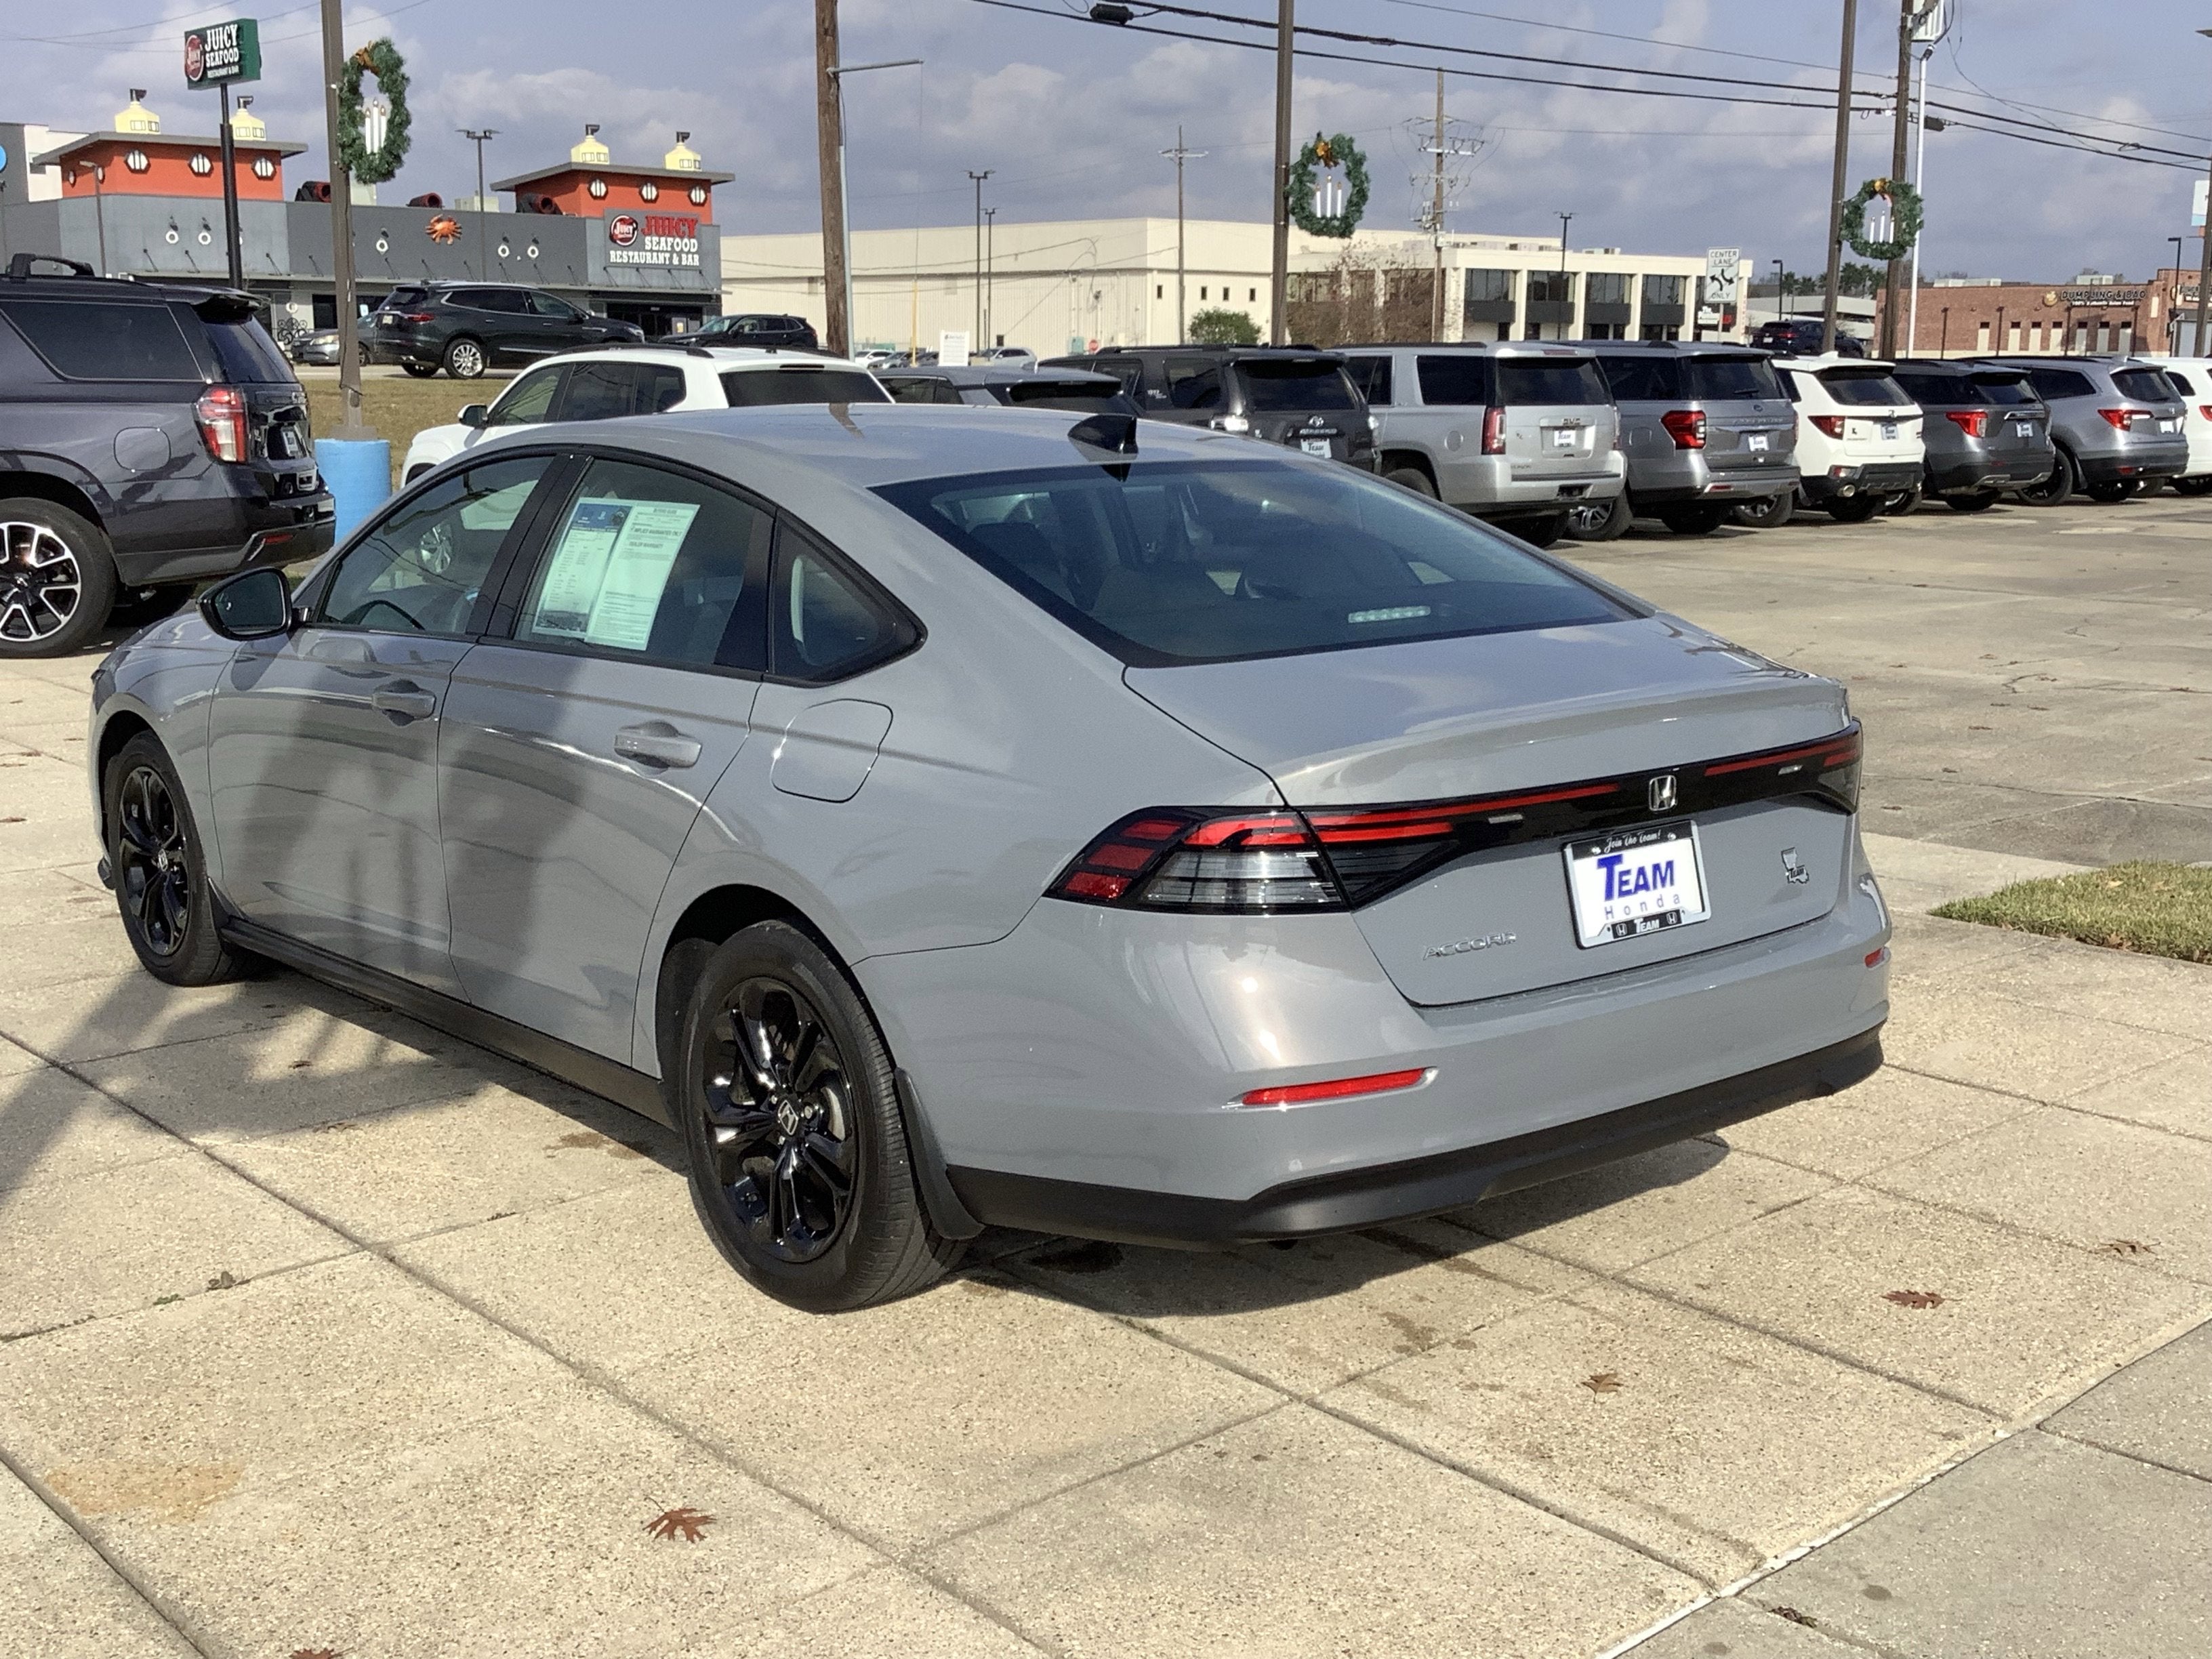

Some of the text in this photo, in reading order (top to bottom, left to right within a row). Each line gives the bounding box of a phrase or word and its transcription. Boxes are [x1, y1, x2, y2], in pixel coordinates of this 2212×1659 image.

[205, 24, 238, 52] JUICY
[205, 47, 239, 68] SEAFOOD
[614, 222, 634, 234] JUICY
[641, 215, 698, 239] JUICY
[644, 236, 698, 252] SEAFOOD
[610, 250, 699, 266] RESTAURANT & BAR
[2062, 290, 2113, 299] DUMPLING
[2123, 290, 2146, 299] BAO
[1604, 829, 1662, 853] Join The Team!
[1597, 853, 1675, 901] TEAM
[1604, 893, 1681, 920] Honda
[1634, 918, 1660, 933] TEAM
[1423, 930, 1517, 961] ACCORD
